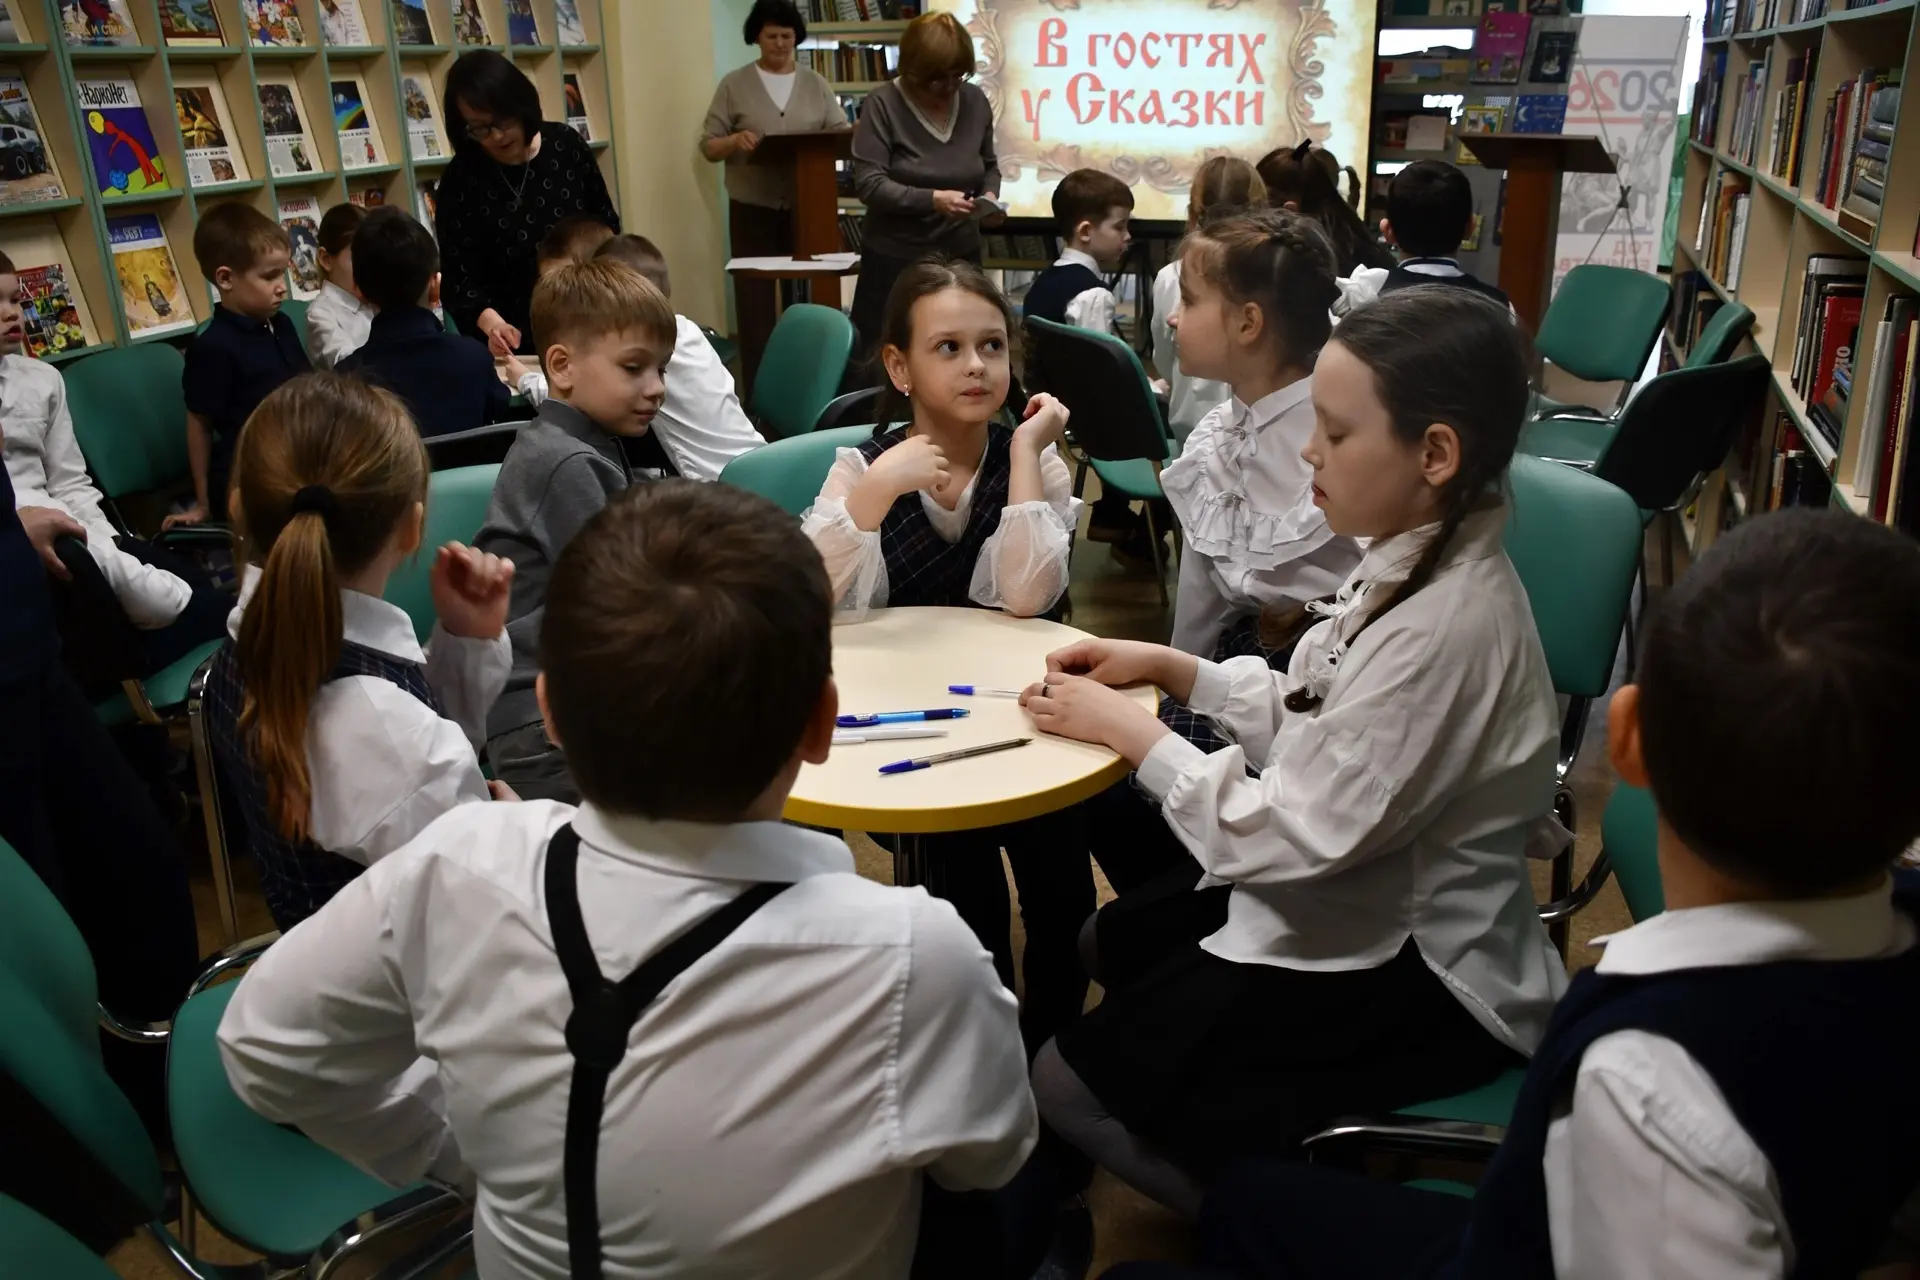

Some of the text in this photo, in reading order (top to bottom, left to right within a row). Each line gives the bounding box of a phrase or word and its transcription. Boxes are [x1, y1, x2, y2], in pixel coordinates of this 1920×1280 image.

[1033, 17, 1266, 84] В гостях
[80, 82, 129, 108] НаркоНет
[1066, 72, 1265, 128] Сказки
